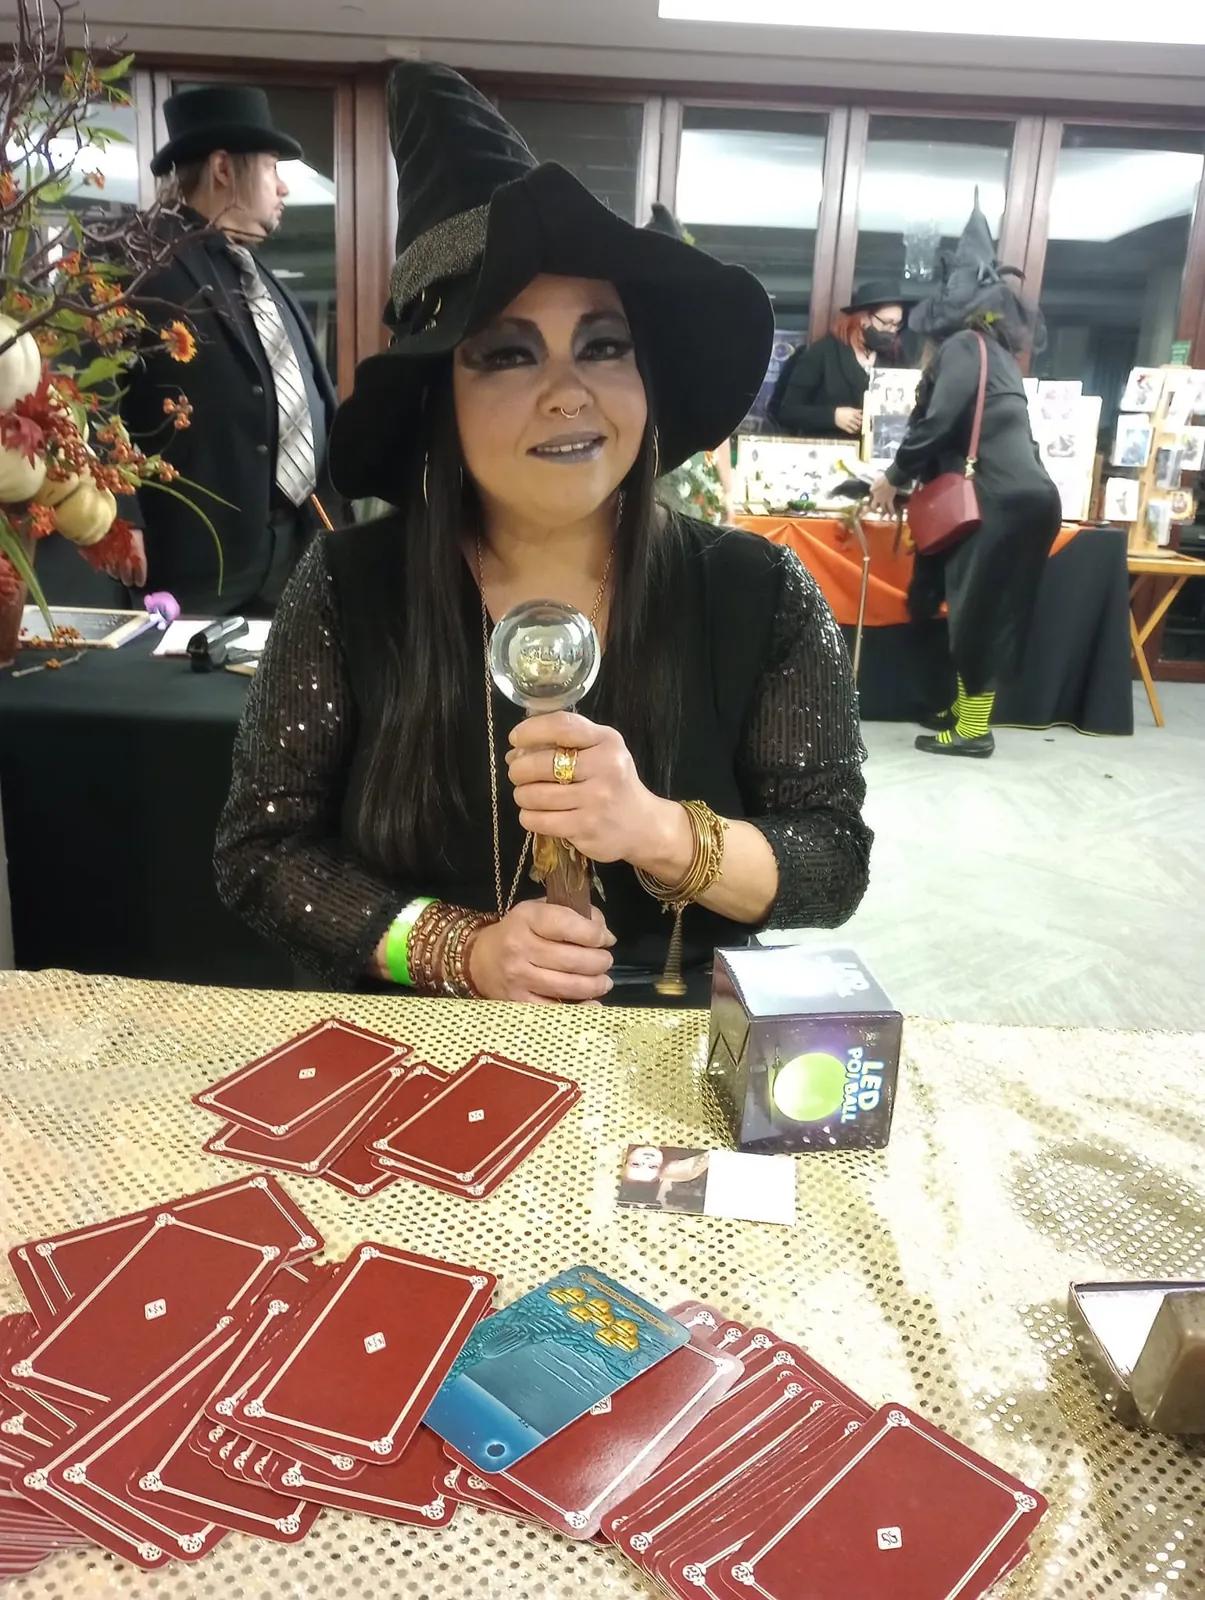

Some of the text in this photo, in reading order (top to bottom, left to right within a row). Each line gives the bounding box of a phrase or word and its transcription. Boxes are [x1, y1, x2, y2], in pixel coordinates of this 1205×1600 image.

[841, 1046, 863, 1124] POI BALL
[858, 1061, 884, 1111] LED
